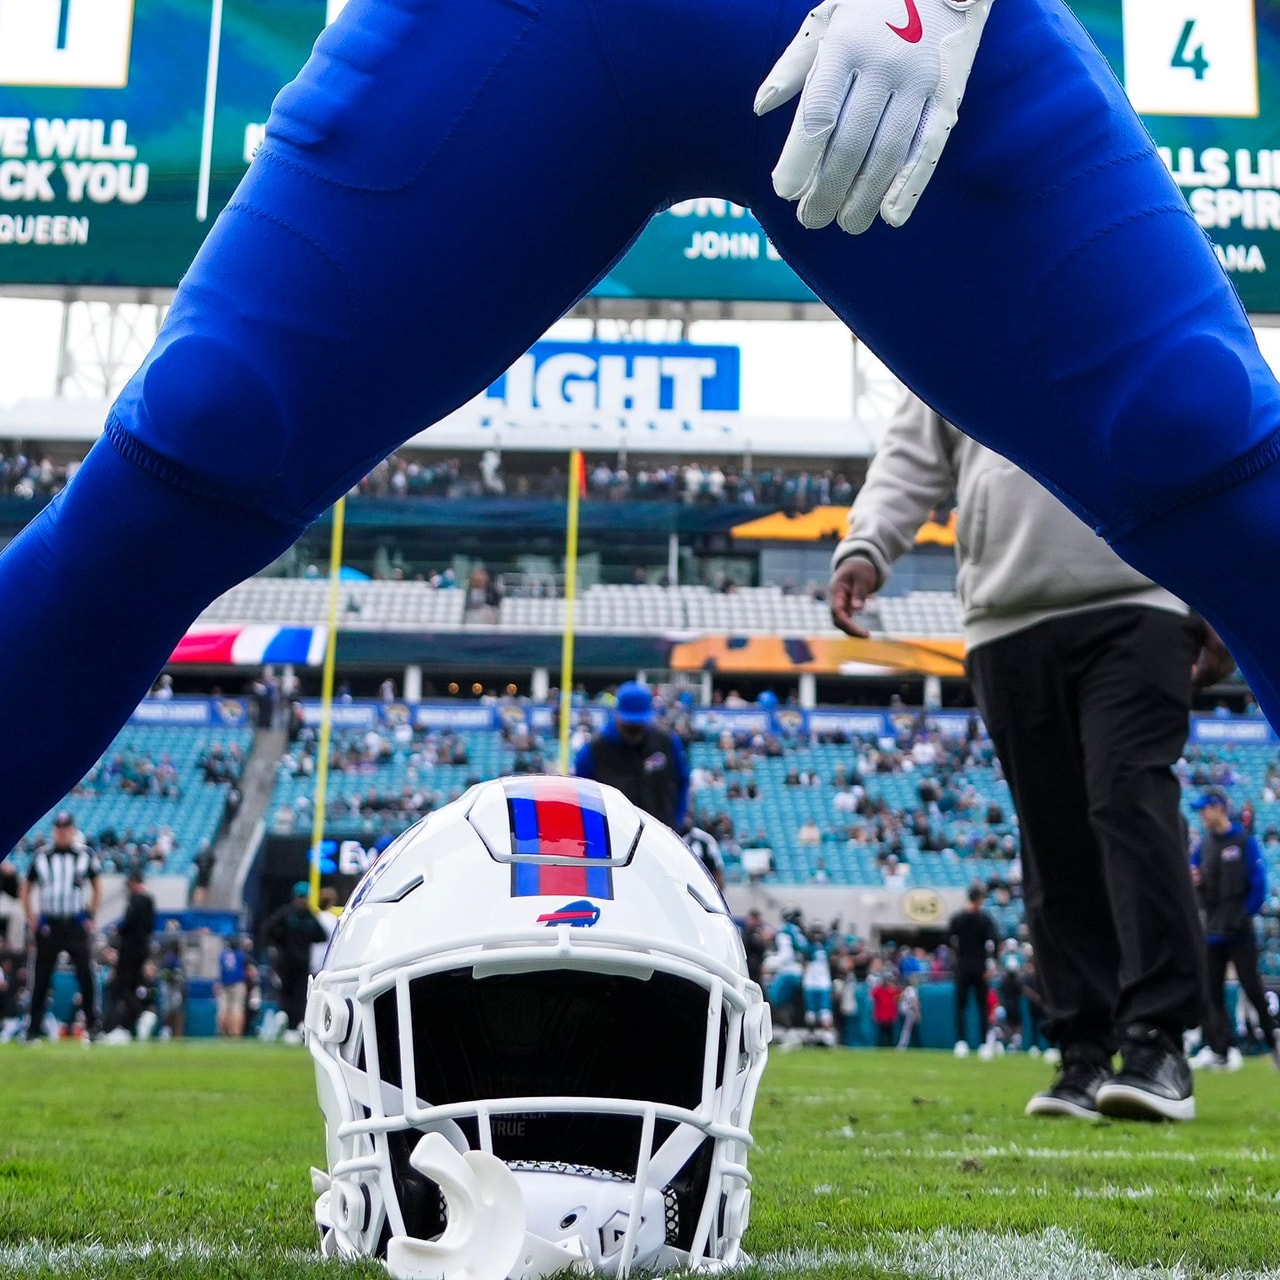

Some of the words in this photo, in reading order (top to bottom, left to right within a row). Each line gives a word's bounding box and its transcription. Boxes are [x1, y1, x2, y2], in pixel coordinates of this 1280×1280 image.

[1170, 20, 1210, 80] 4
[33, 118, 138, 160] WILL
[59, 162, 150, 204] YOU
[683, 231, 759, 260] JOHN
[482, 352, 717, 415] IGHT
[490, 1121, 526, 1137] TRUE
